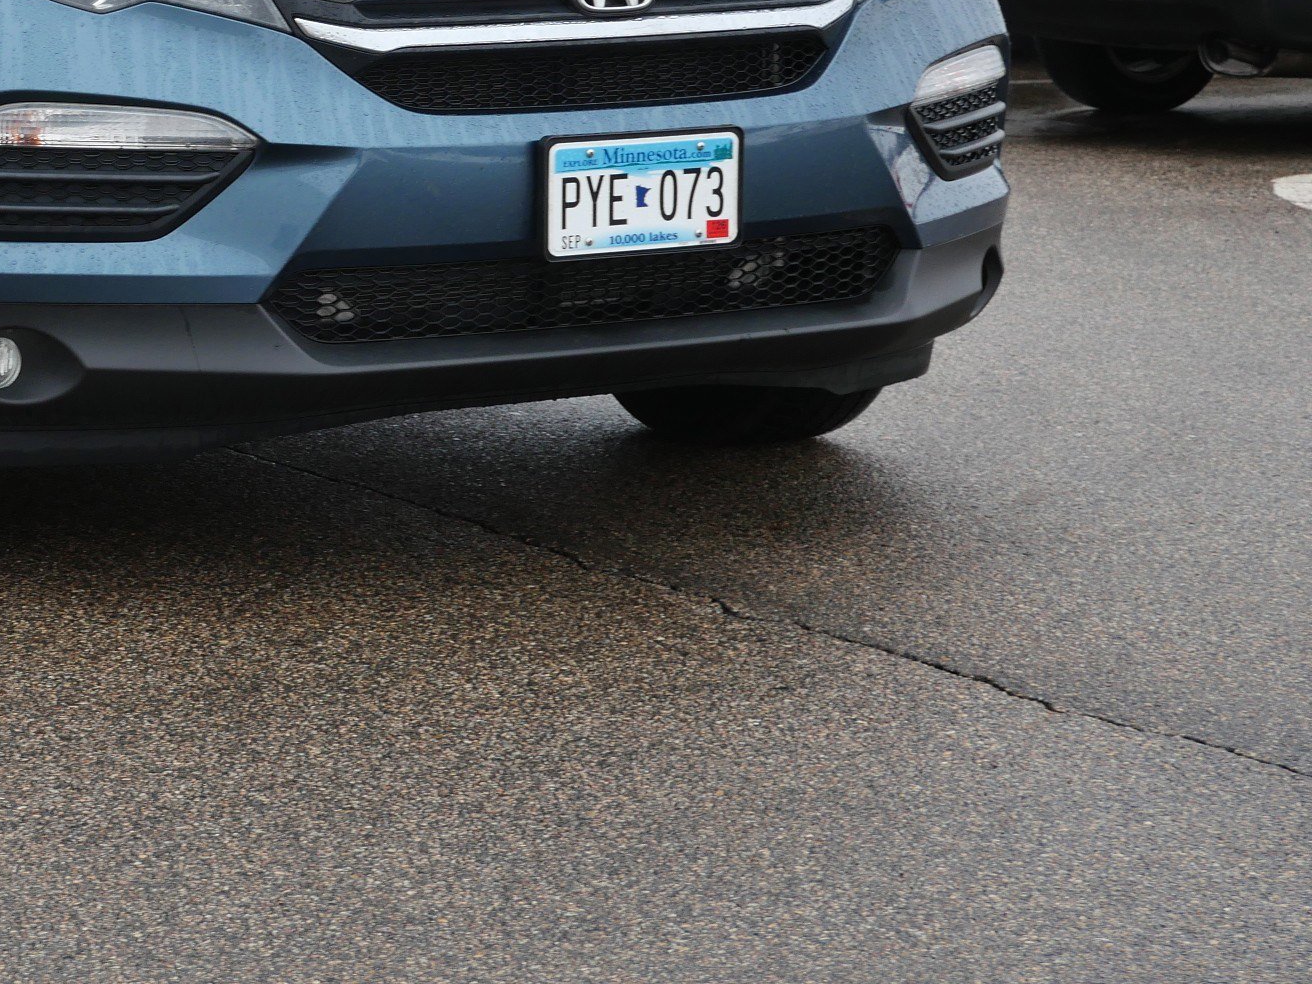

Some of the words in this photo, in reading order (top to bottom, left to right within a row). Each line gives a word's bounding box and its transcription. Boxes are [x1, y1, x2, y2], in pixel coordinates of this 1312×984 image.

[561, 173, 629, 230] PYE
[659, 166, 725, 221] 073
[561, 235, 582, 250] SEP
[649, 231, 678, 242] lakes
